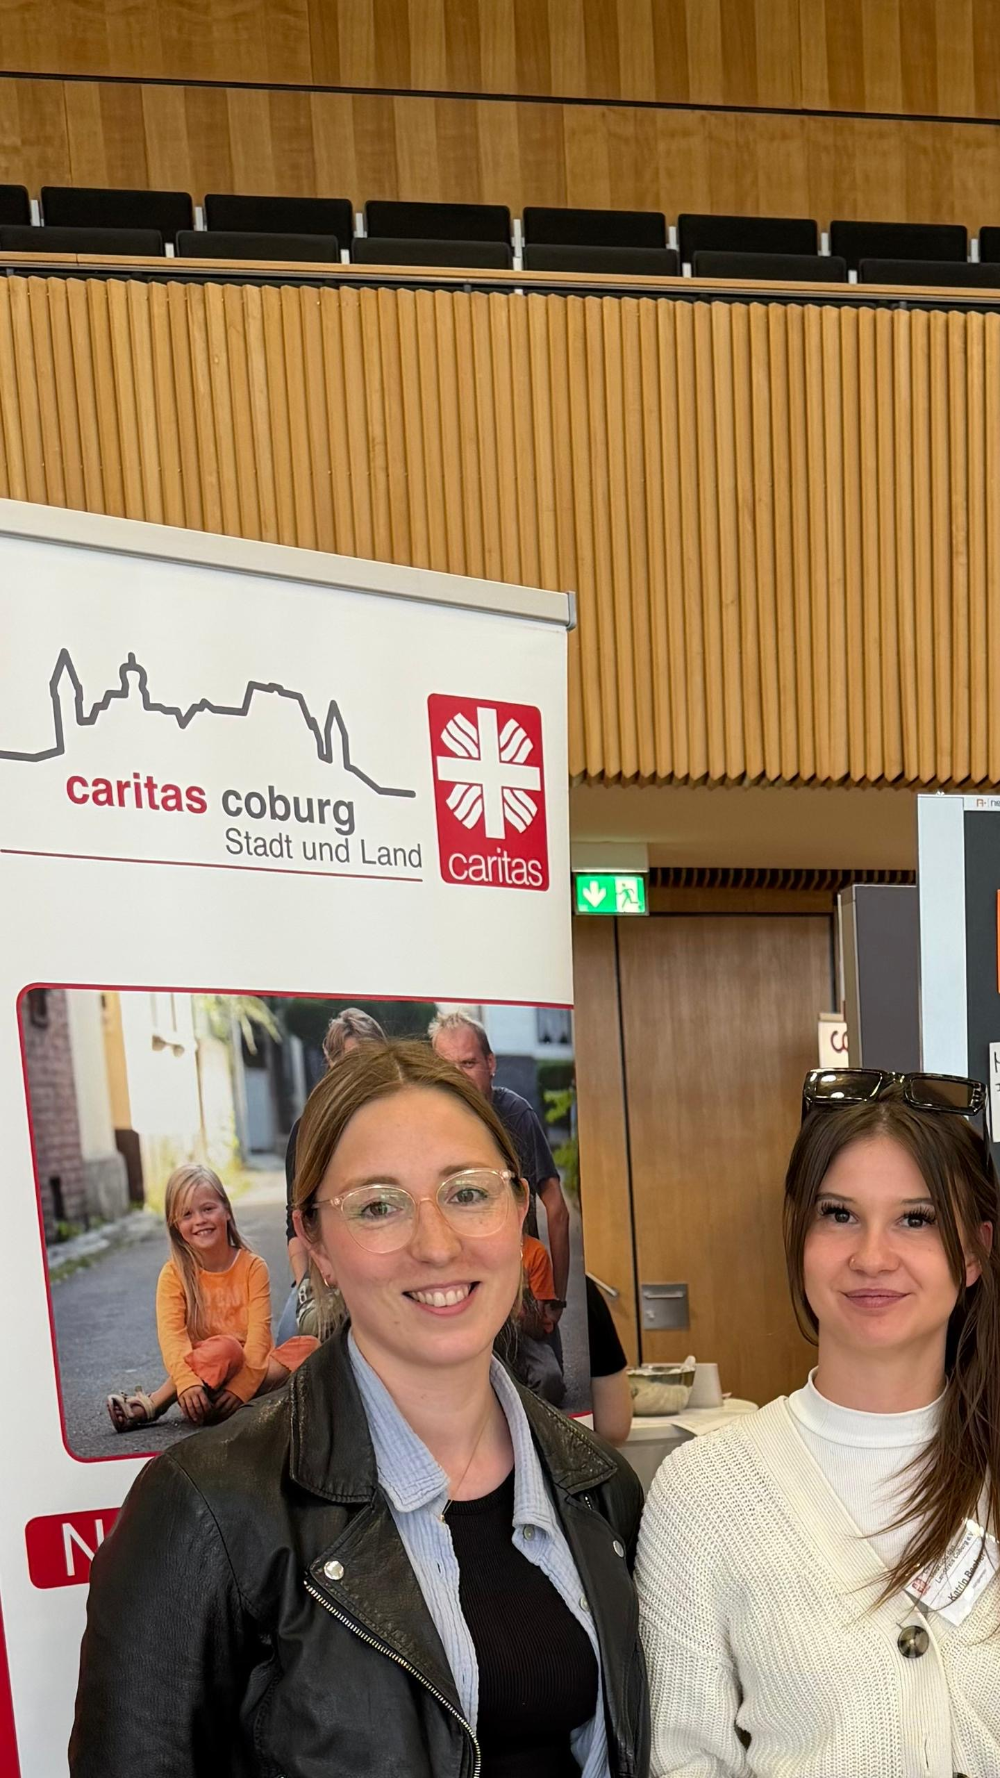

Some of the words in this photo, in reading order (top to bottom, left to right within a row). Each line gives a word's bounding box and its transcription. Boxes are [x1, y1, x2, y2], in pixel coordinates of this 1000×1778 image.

[66, 773, 207, 814] caritas
[221, 785, 356, 835] coburg
[225, 829, 294, 861] Stadt
[302, 839, 349, 864] und
[361, 840, 423, 869] Land
[449, 848, 543, 887] caritas
